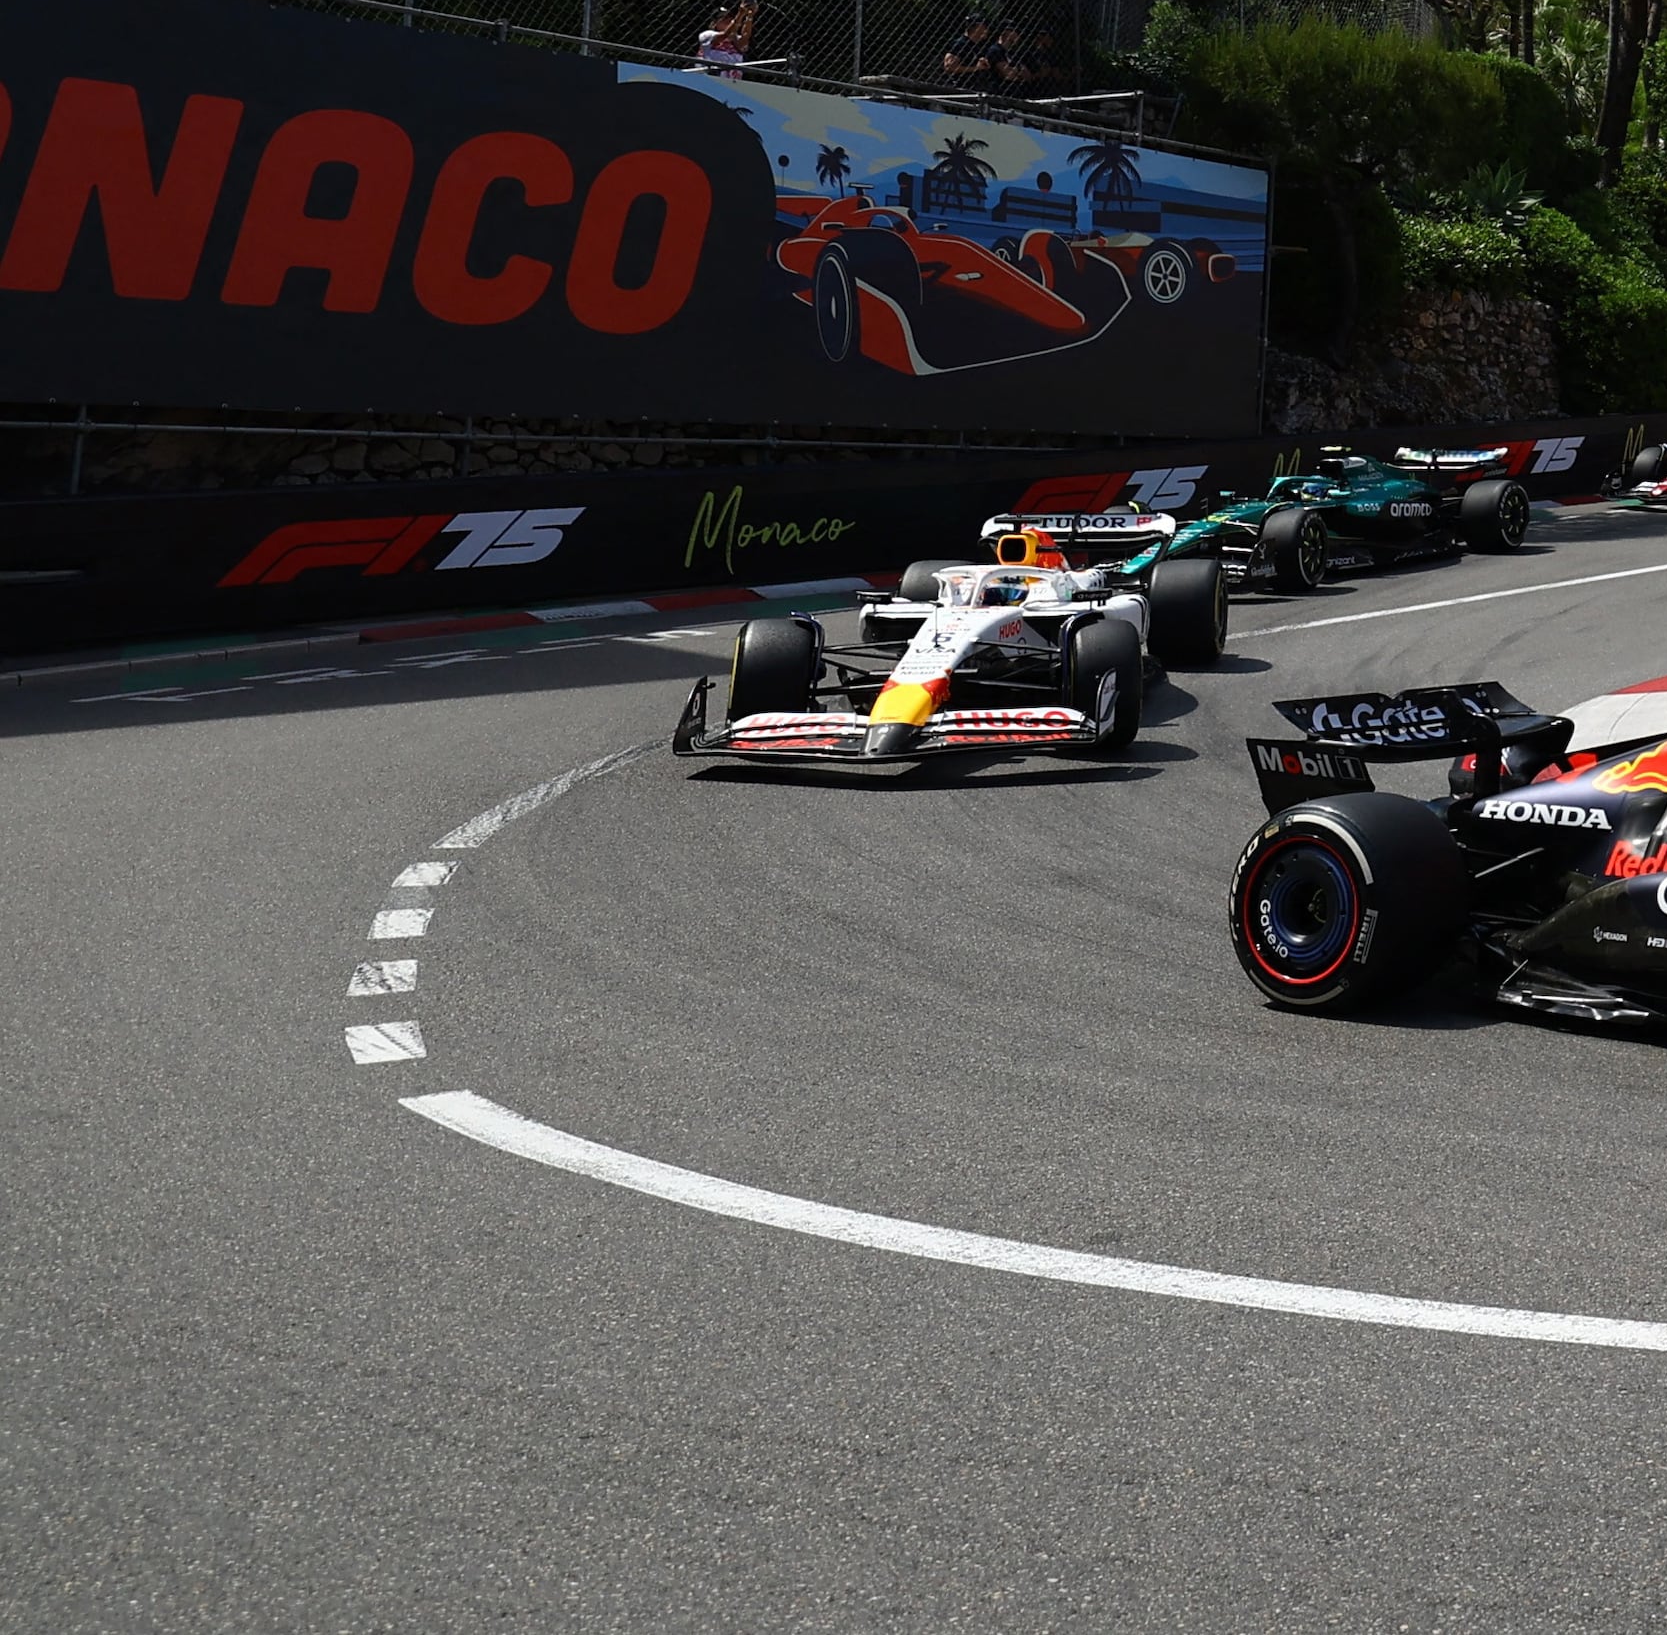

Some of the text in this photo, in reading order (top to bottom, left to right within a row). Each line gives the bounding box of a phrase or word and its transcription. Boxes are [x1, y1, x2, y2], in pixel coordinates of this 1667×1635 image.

[0, 76, 712, 335] NACO
[1530, 436, 1586, 475] 75
[1126, 465, 1209, 510] 75
[1039, 514, 1127, 529] TUDOR
[1357, 502, 1381, 513] BOSS
[1390, 501, 1433, 518] aramco
[684, 484, 855, 576] Monaco
[216, 506, 588, 589] F1 75
[1325, 555, 1356, 570] gnizant
[999, 618, 1023, 640] HUGO
[953, 709, 1071, 729] HUGO
[1256, 744, 1336, 778] Mobil
[1479, 799, 1613, 831] HONDA
[1260, 898, 1289, 959] Gate.io
[1352, 908, 1379, 965] PIRELLI
[1602, 932, 1628, 943] HEXAGON
